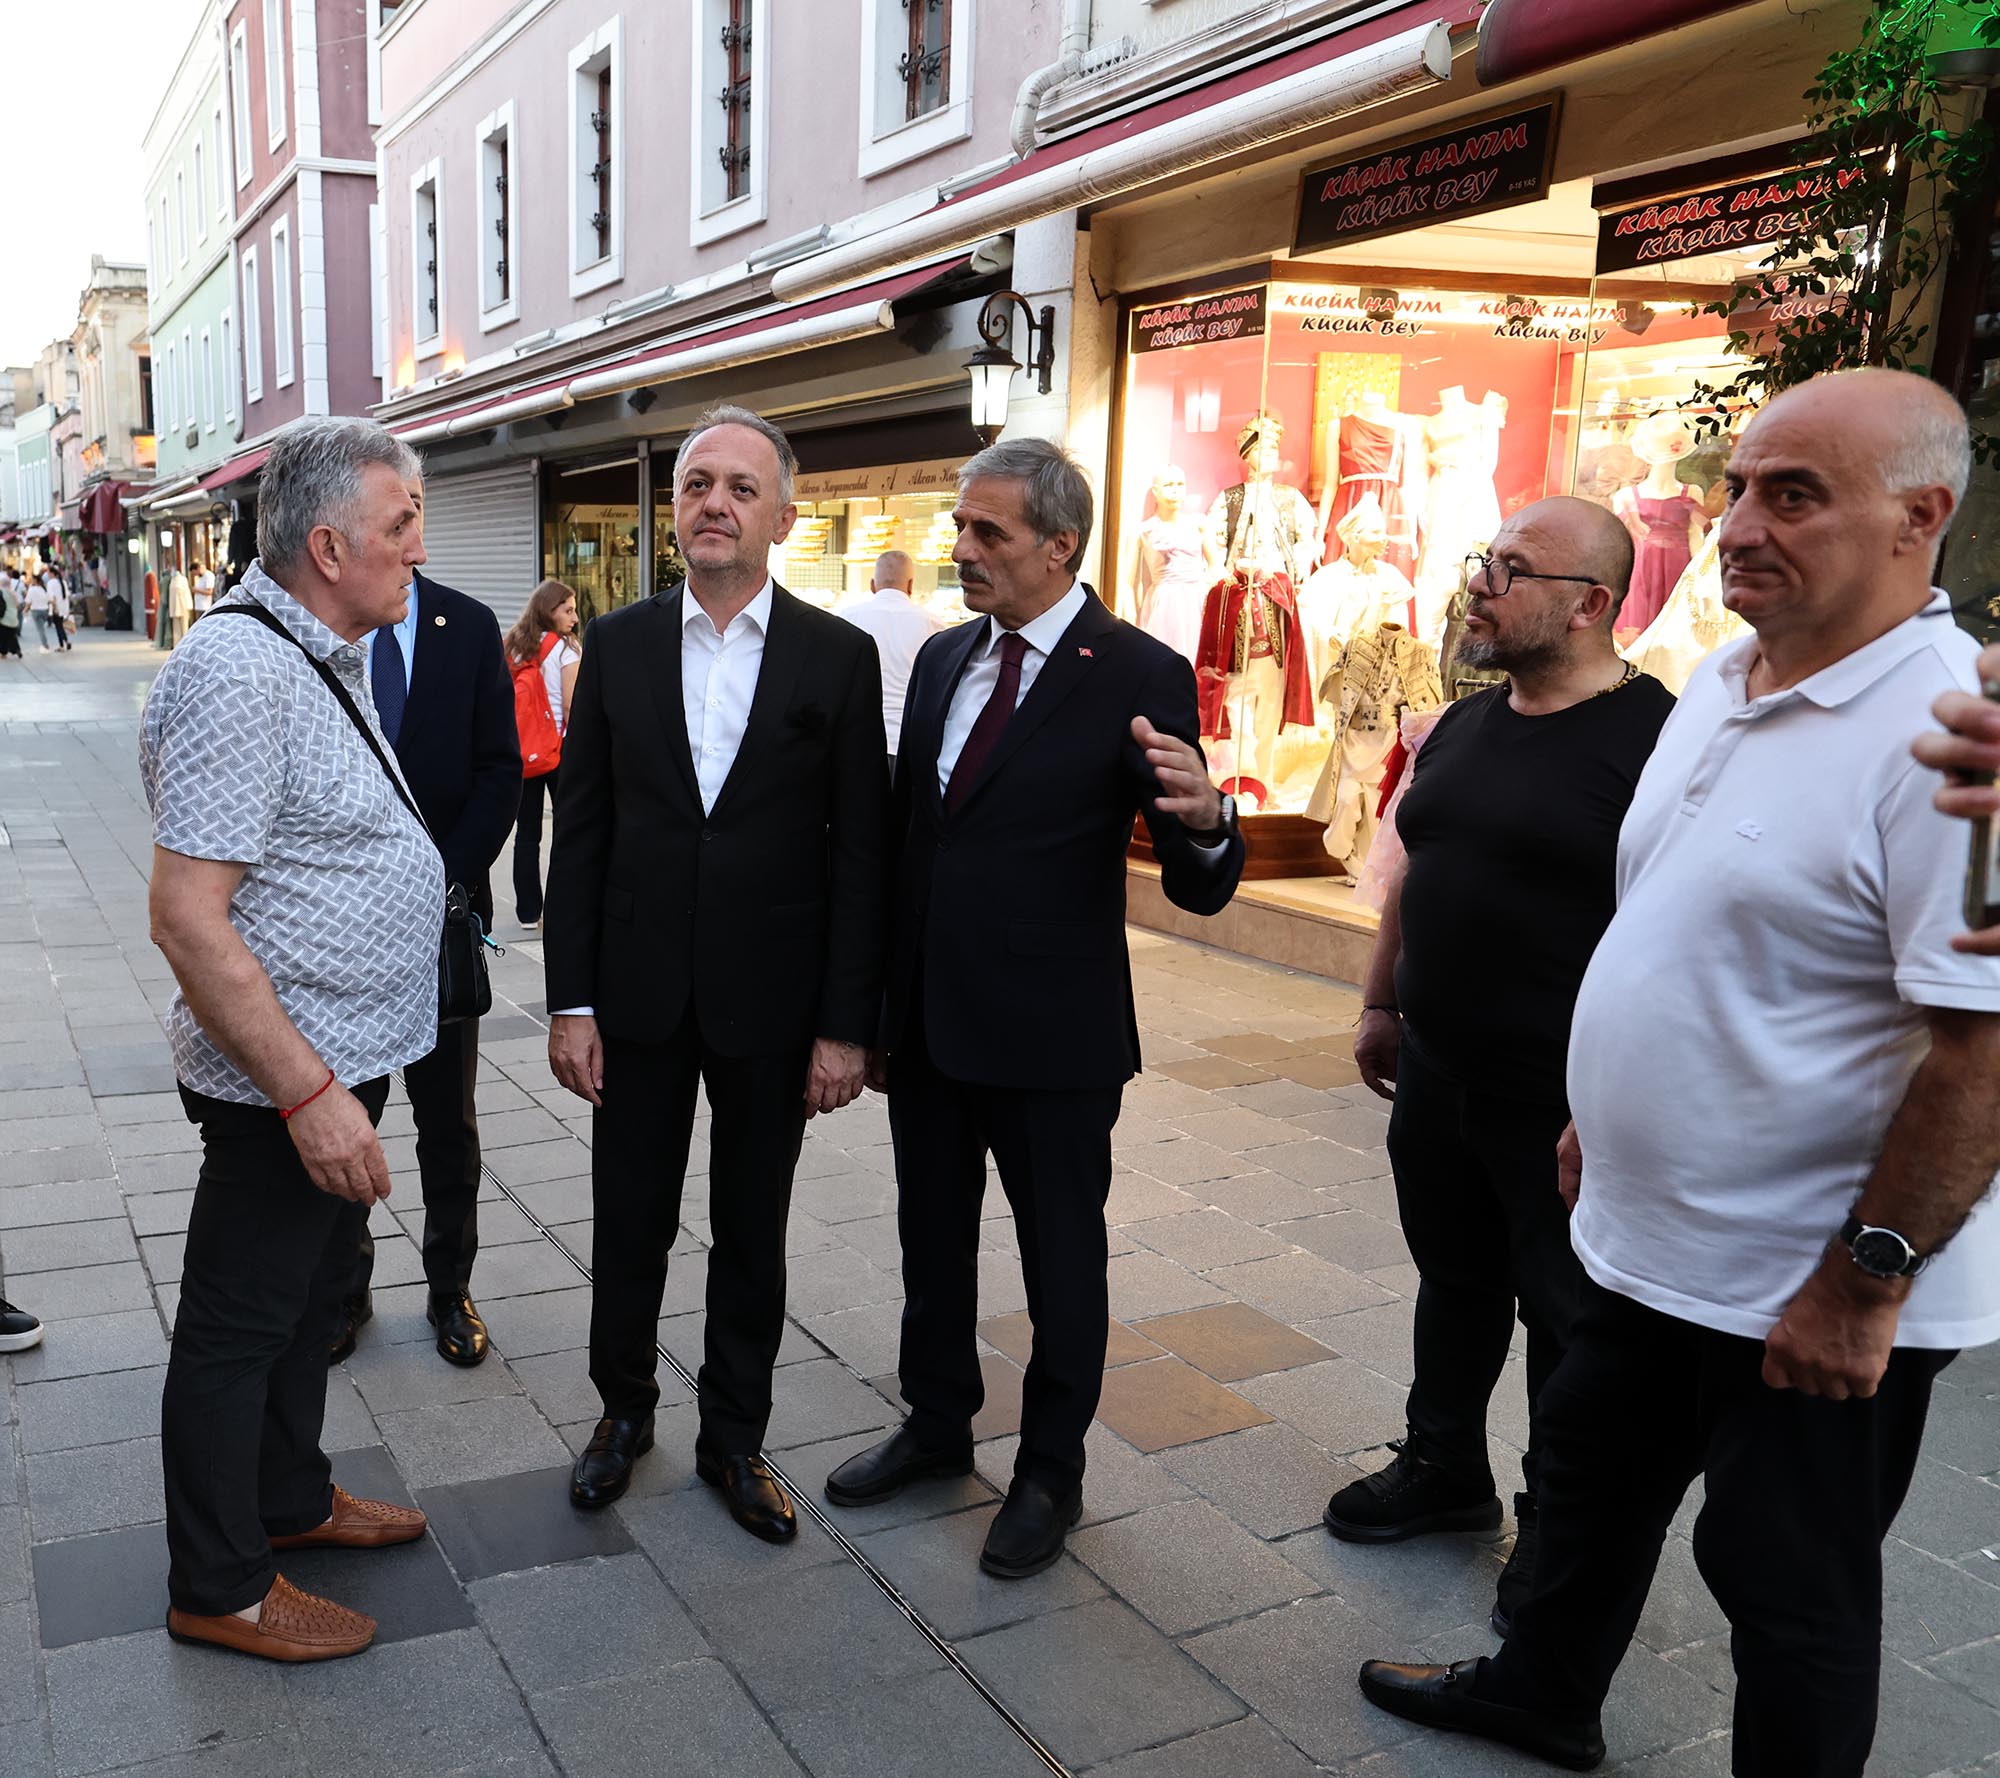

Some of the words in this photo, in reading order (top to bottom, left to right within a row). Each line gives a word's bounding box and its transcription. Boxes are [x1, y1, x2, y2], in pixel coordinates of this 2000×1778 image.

[1321, 156, 1412, 202] KÜÇÜK
[1415, 123, 1528, 176] HANIM
[1336, 185, 1431, 231] KÜÇÜK
[1434, 168, 1499, 210] BEY
[1615, 195, 1724, 237] KÜÇÜK
[1636, 220, 1750, 261] KÜÇÜK
[1139, 304, 1193, 329] KÜÇÜK
[1194, 293, 1258, 319] HANIM
[1284, 293, 1358, 310] KÜÇÜK
[1363, 296, 1443, 314] HANIM
[1478, 300, 1548, 318] KÜÇÜK
[1150, 324, 1205, 347] KÜÇÜK
[1206, 318, 1243, 341] BEY
[1380, 320, 1424, 338] BEY
[1493, 321, 1562, 340] KÜÇÜK
